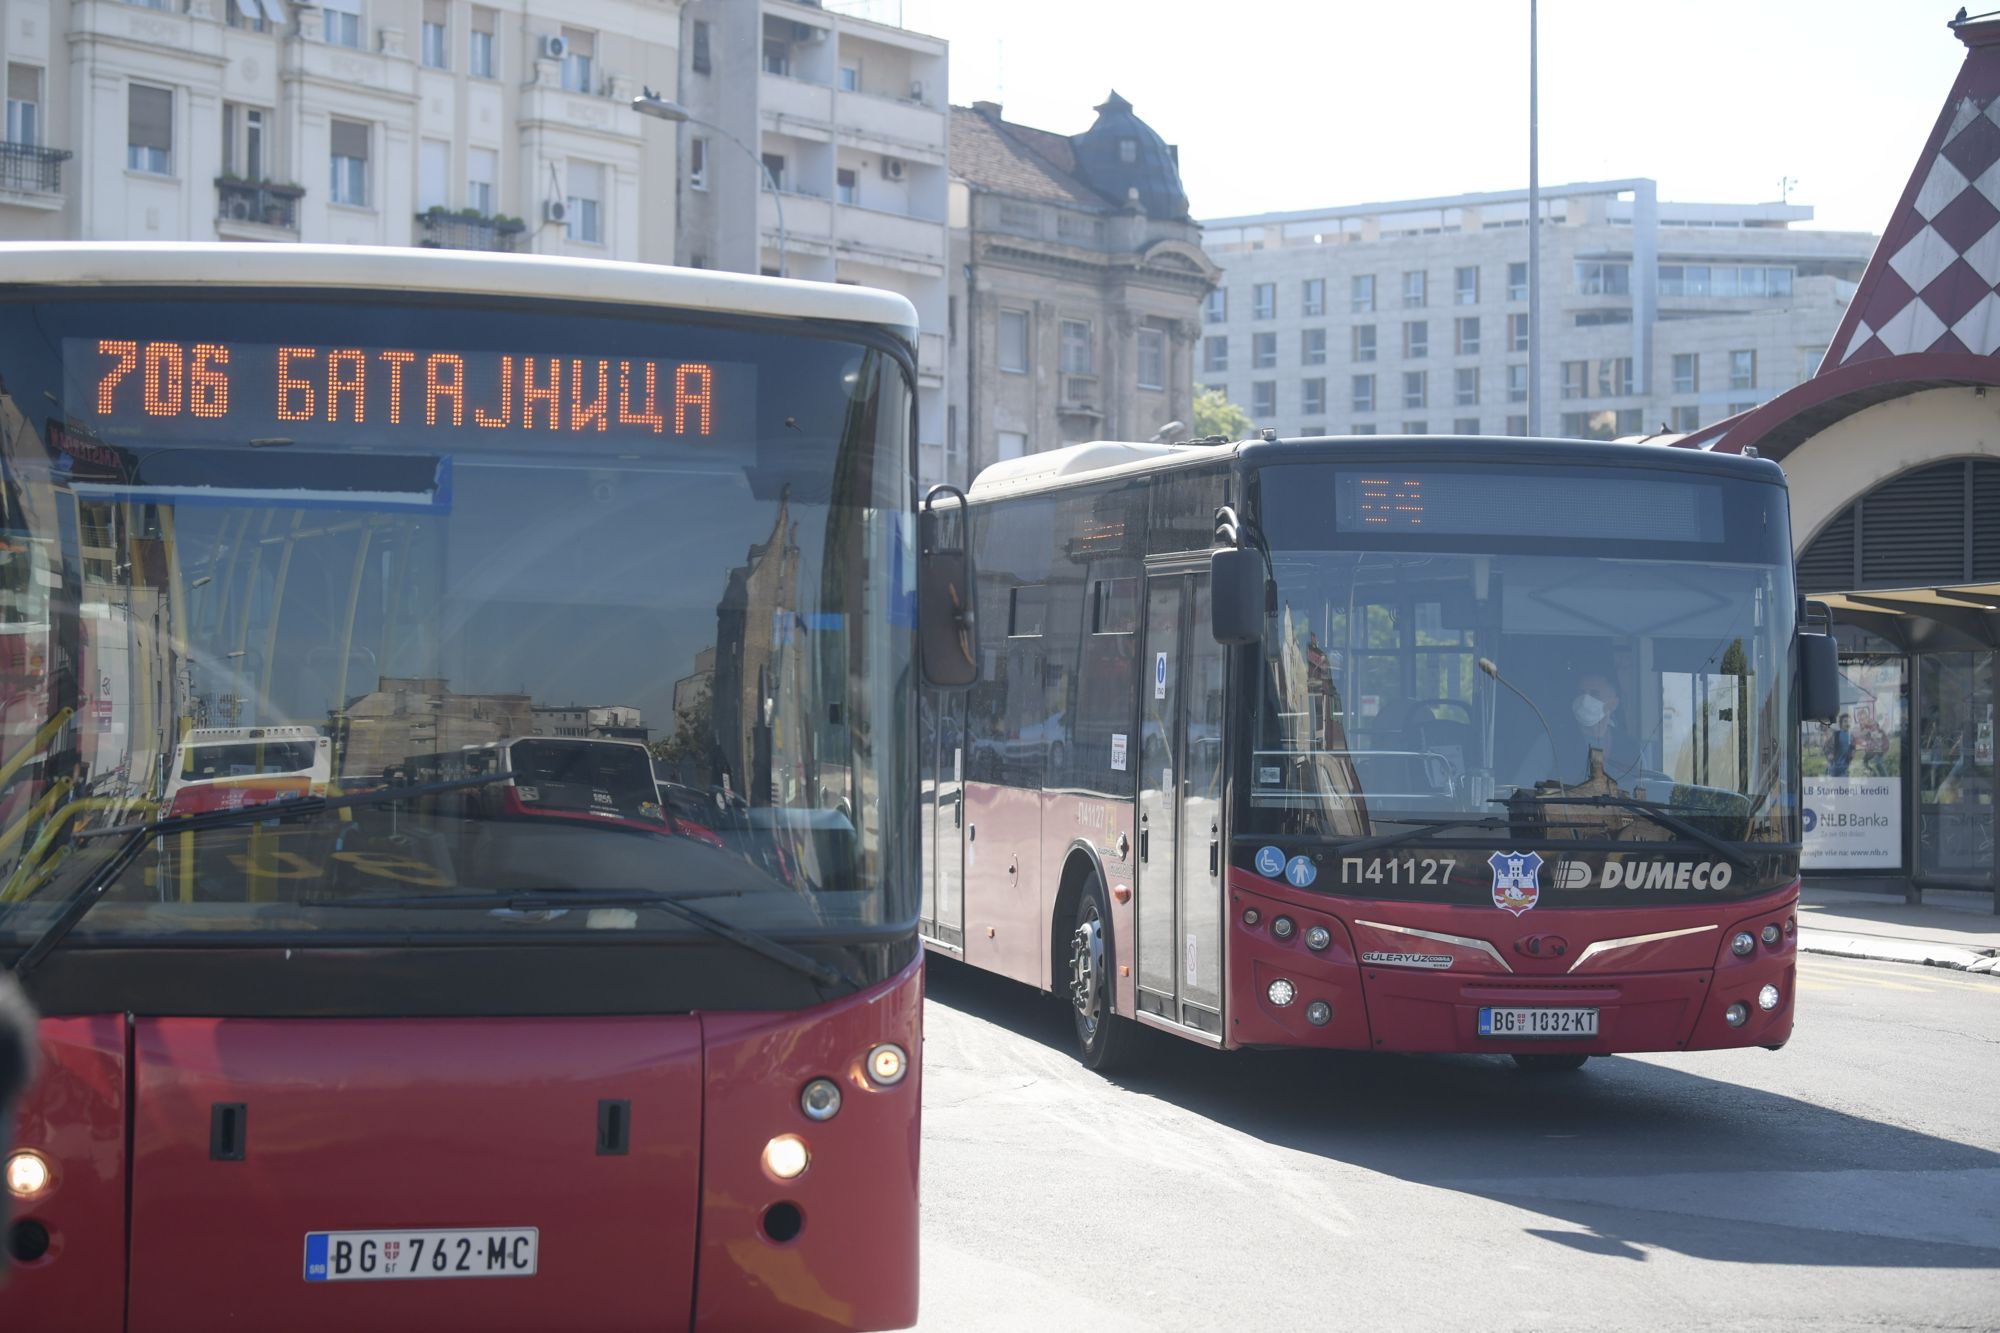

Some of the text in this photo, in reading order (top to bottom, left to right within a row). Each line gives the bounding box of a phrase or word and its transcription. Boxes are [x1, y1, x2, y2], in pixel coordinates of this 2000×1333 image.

[97, 340, 712, 435] 706 БАТАЈНИЦА
[1803, 786, 1814, 796] LB
[1860, 785, 1889, 796] krediti
[1820, 811, 1889, 827] NLB Banka
[1850, 847, 1889, 857] www.nlb.rs
[1341, 857, 1457, 885] П41127
[1600, 861, 1733, 890] DUMECO
[1494, 1011, 1515, 1031] BG
[334, 1239, 377, 1274] BG
